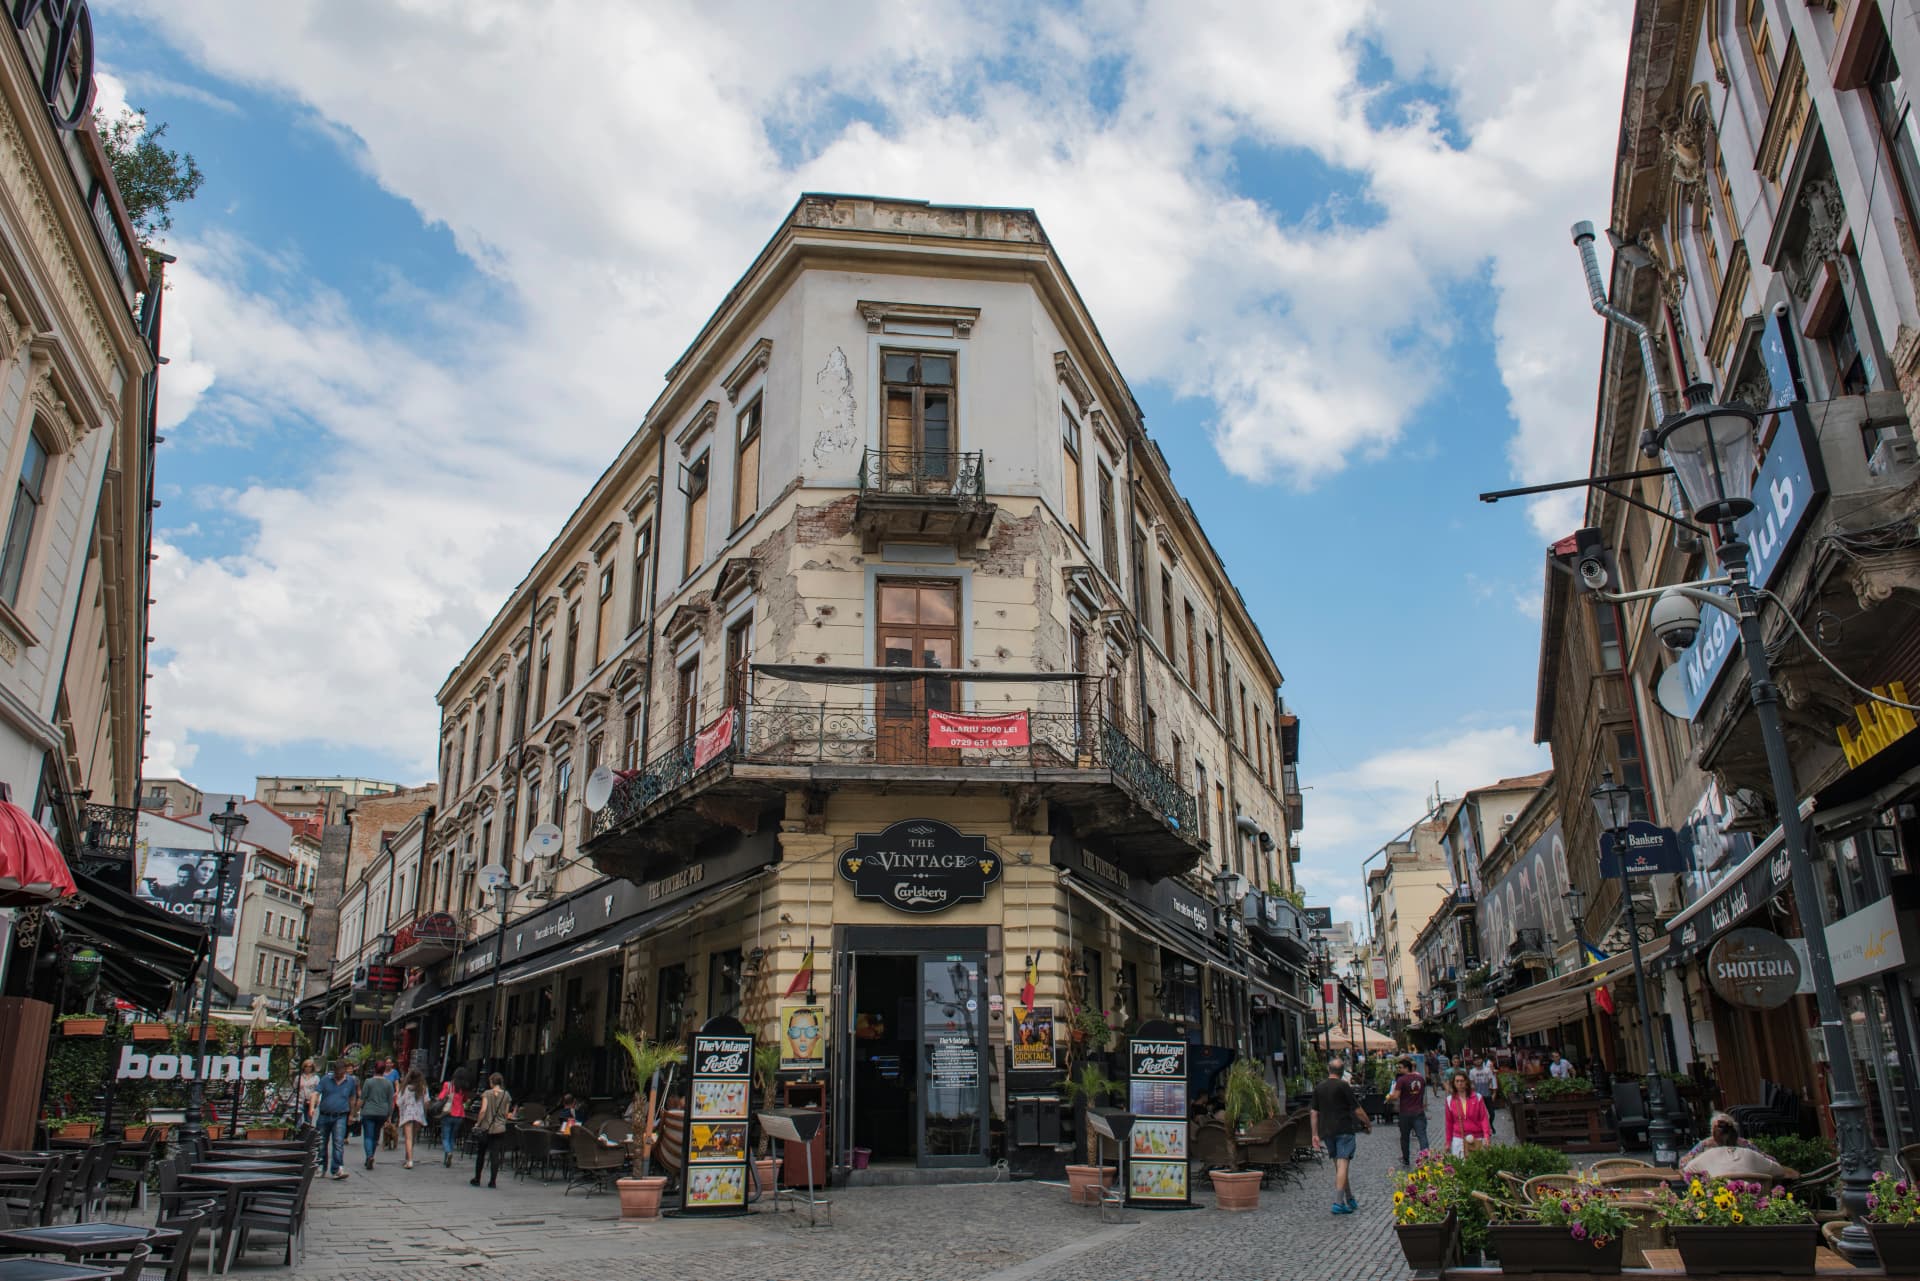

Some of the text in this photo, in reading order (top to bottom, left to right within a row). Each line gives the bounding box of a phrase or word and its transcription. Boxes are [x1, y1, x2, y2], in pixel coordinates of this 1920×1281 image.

[1750, 476, 1794, 582] lub
[940, 725, 1017, 734] SALARIU 2000 LEI
[908, 839, 935, 848] THE
[1628, 832, 1664, 846] Bankers
[877, 851, 968, 871] VINTAGE
[894, 882, 948, 905] Carlsberg
[1717, 960, 1796, 979] SHOTERIA
[116, 1045, 272, 1081] bound
